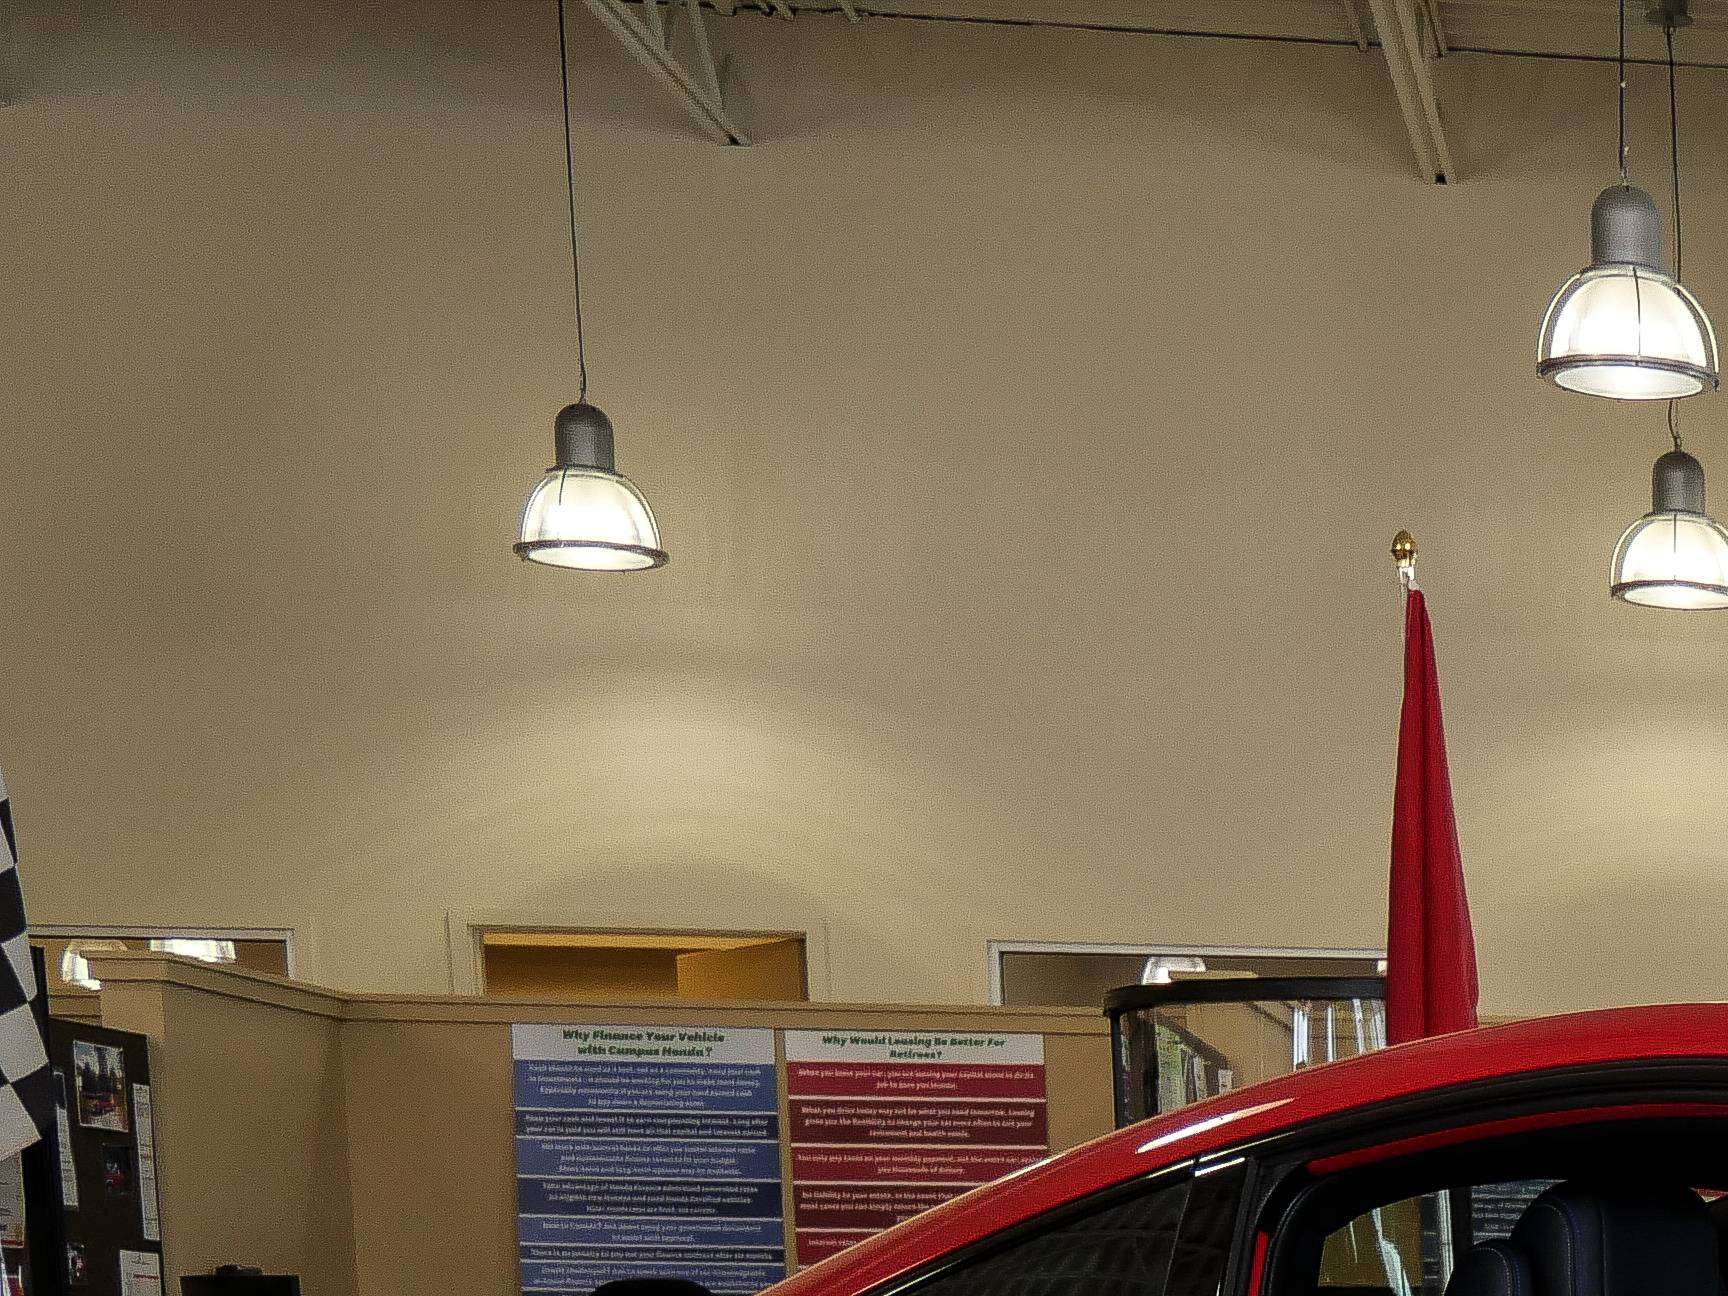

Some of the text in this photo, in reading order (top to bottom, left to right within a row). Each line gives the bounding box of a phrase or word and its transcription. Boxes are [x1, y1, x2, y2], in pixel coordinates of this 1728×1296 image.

[563, 1029, 725, 1043] Why Finance Your Vehicle
[821, 1035, 1007, 1048] Why Would Leasing Be Better For
[577, 1045, 606, 1055] with
[661, 1046, 713, 1057] Honda?
[889, 1050, 943, 1059] Retirees?
